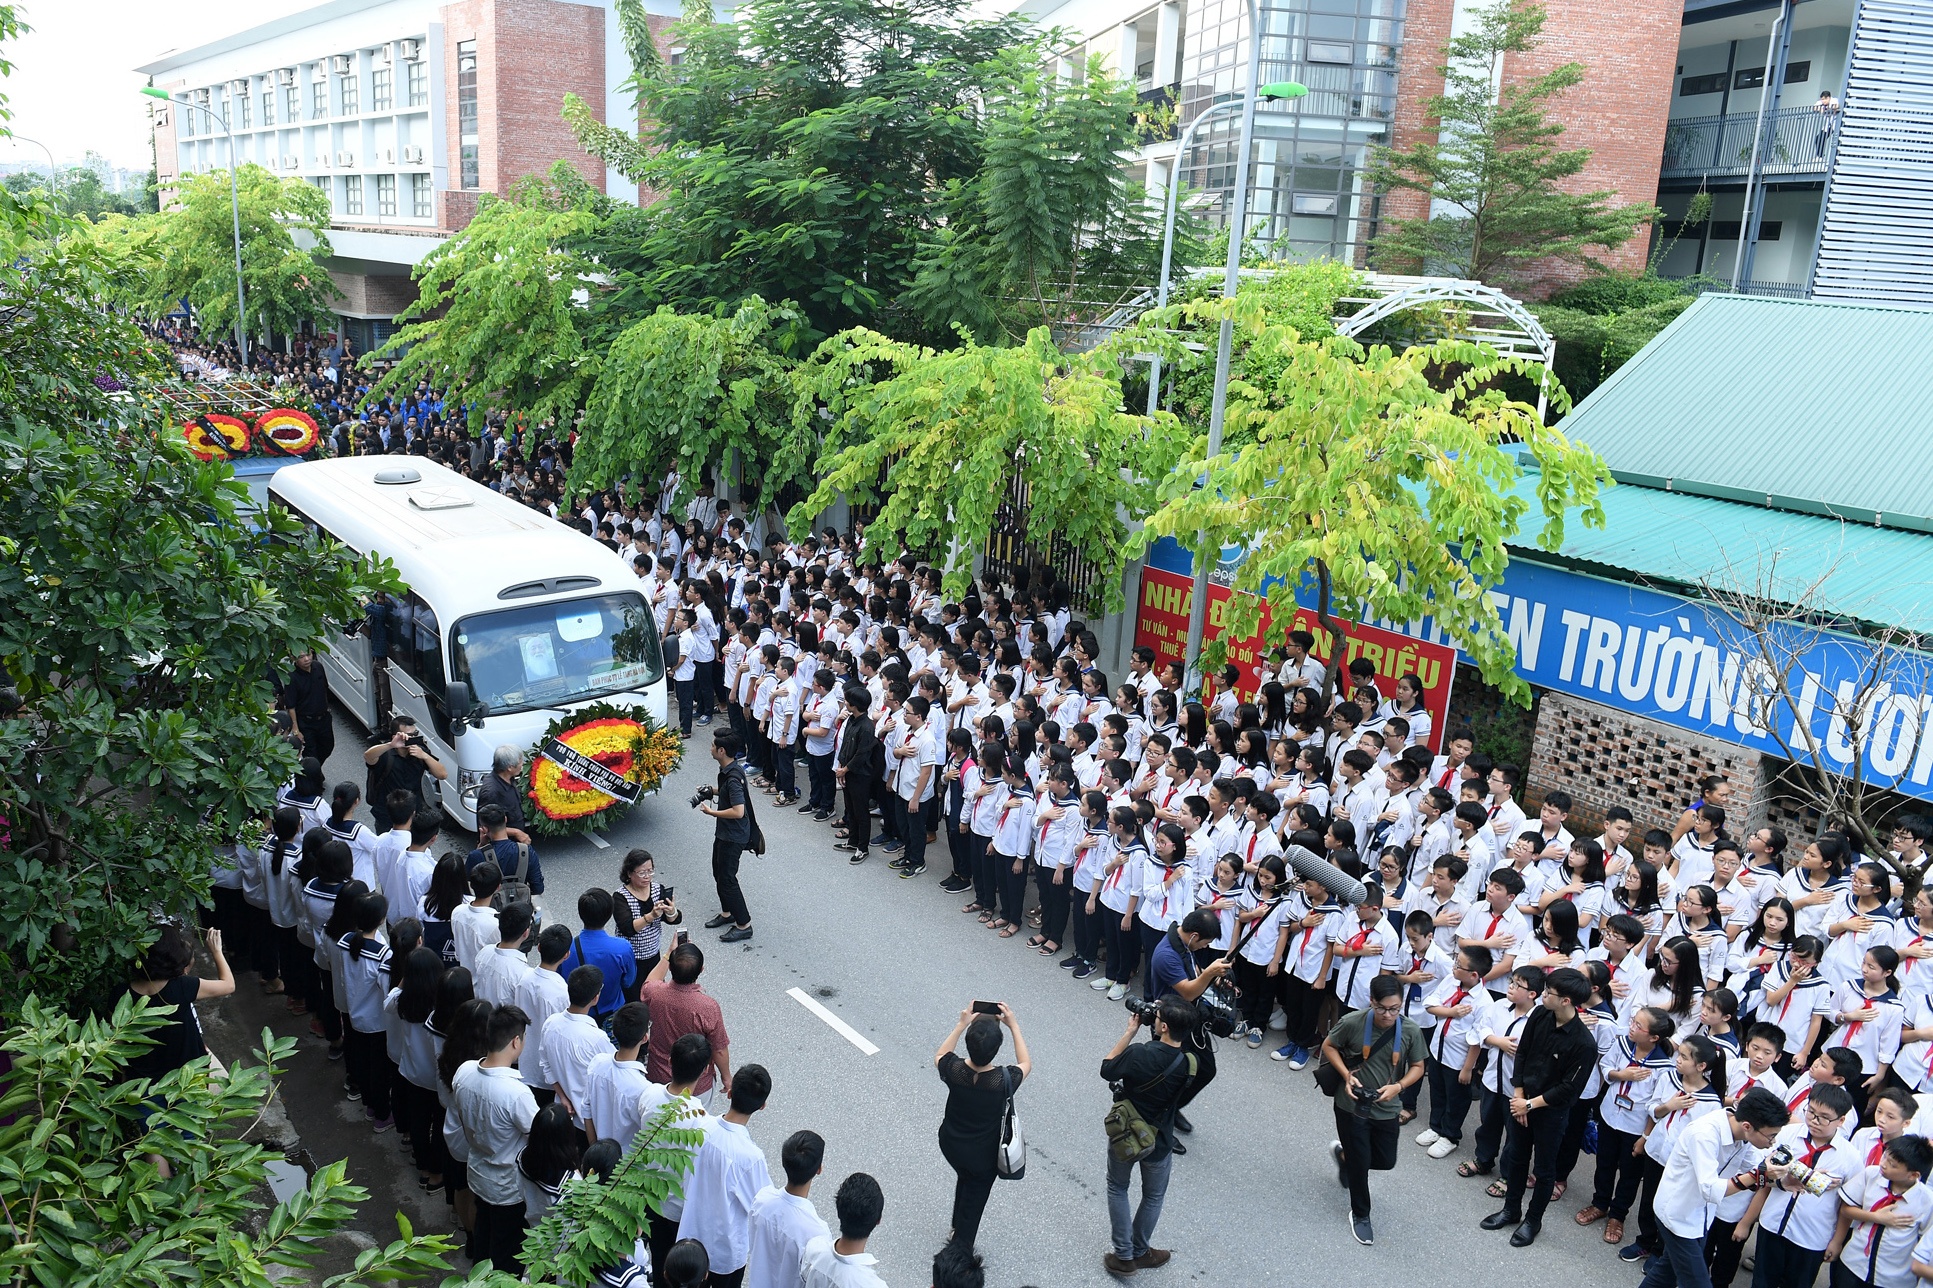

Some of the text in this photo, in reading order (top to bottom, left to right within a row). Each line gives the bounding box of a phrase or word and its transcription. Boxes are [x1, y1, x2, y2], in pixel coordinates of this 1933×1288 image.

[1208, 568, 1238, 581] epsi
[1176, 629, 1188, 644] MU
[1344, 636, 1440, 690] TRIỀU
[1558, 608, 1780, 739] TRƯỜNG
